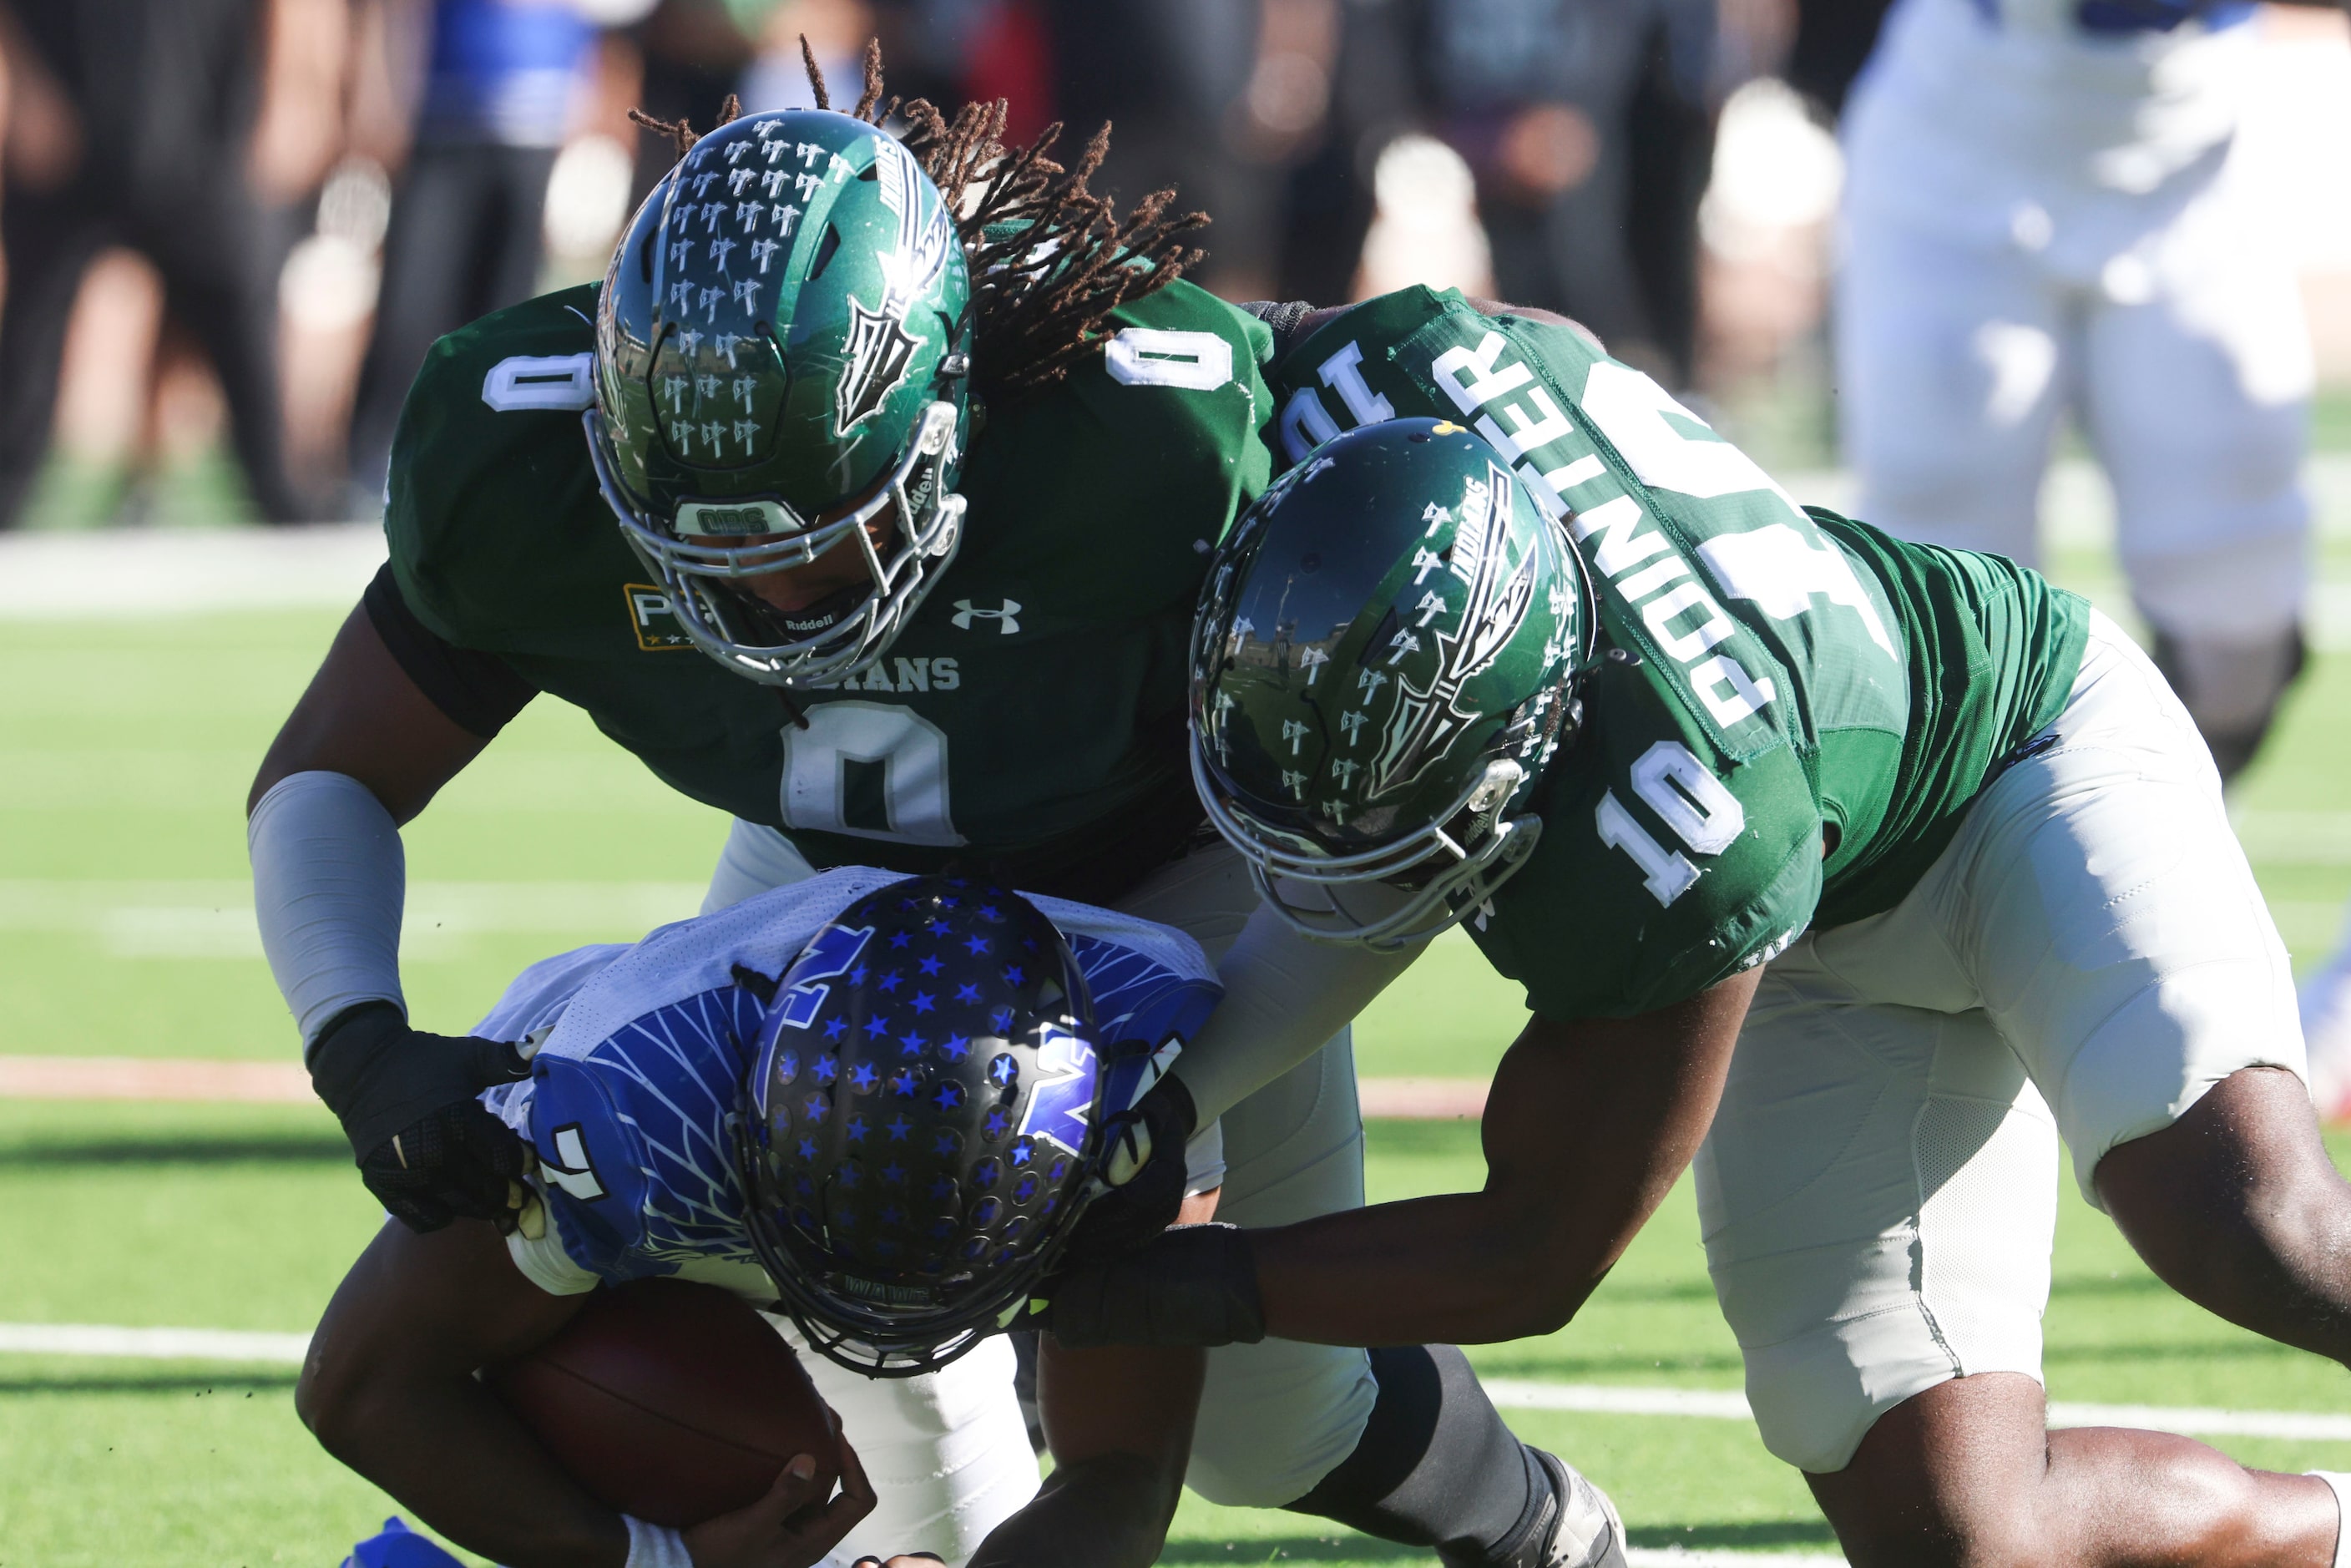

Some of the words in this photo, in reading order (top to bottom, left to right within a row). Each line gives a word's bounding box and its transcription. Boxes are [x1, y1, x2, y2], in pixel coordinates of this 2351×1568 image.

[482, 352, 595, 412] 0
[1105, 327, 1232, 391] 0
[1432, 331, 1776, 729] POINTER
[1450, 477, 1489, 585] INDIANS
[786, 615, 833, 631] Riddell
[1595, 740, 1745, 908] 10
